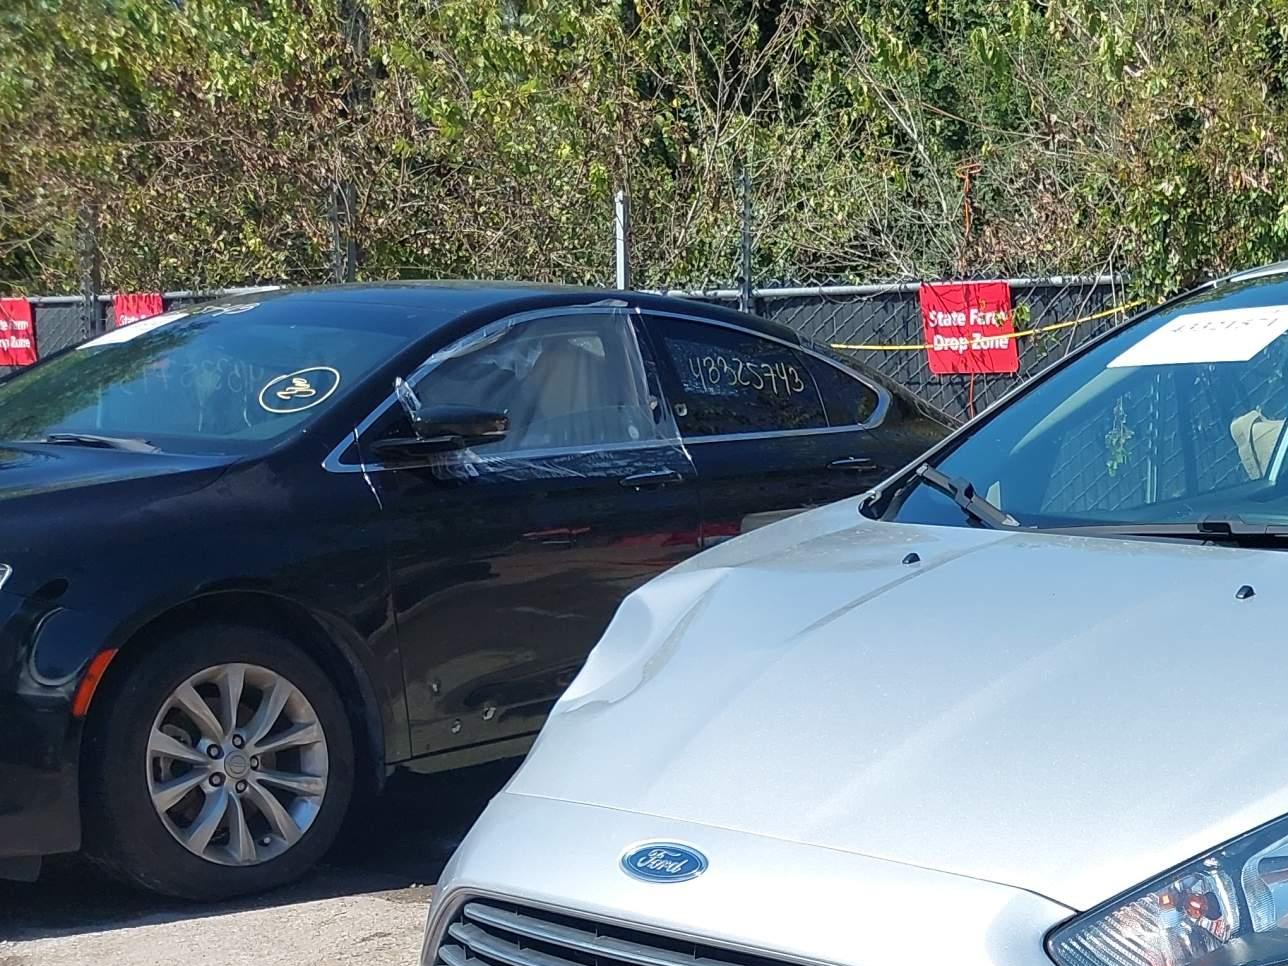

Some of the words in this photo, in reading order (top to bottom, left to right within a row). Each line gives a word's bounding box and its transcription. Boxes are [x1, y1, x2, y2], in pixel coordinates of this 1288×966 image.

[928, 310, 967, 328] State
[933, 334, 968, 354] Drop
[971, 333, 1009, 350] Zone
[636, 848, 689, 874] Ford
